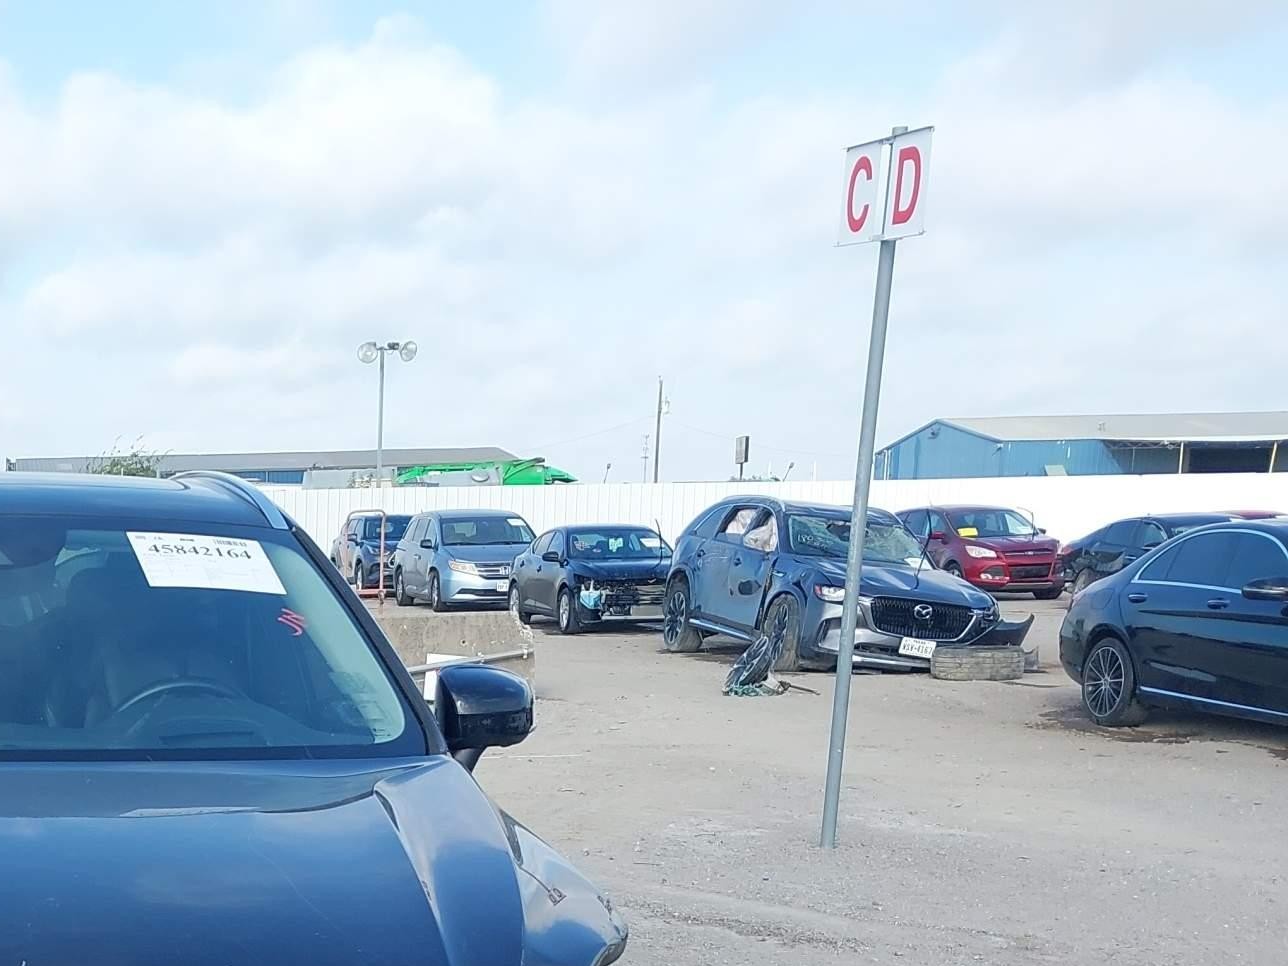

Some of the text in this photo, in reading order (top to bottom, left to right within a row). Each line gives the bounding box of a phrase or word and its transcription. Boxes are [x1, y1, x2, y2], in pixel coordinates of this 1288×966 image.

[847, 156, 873, 232] C
[892, 146, 921, 225] D
[148, 543, 252, 560] 45842164
